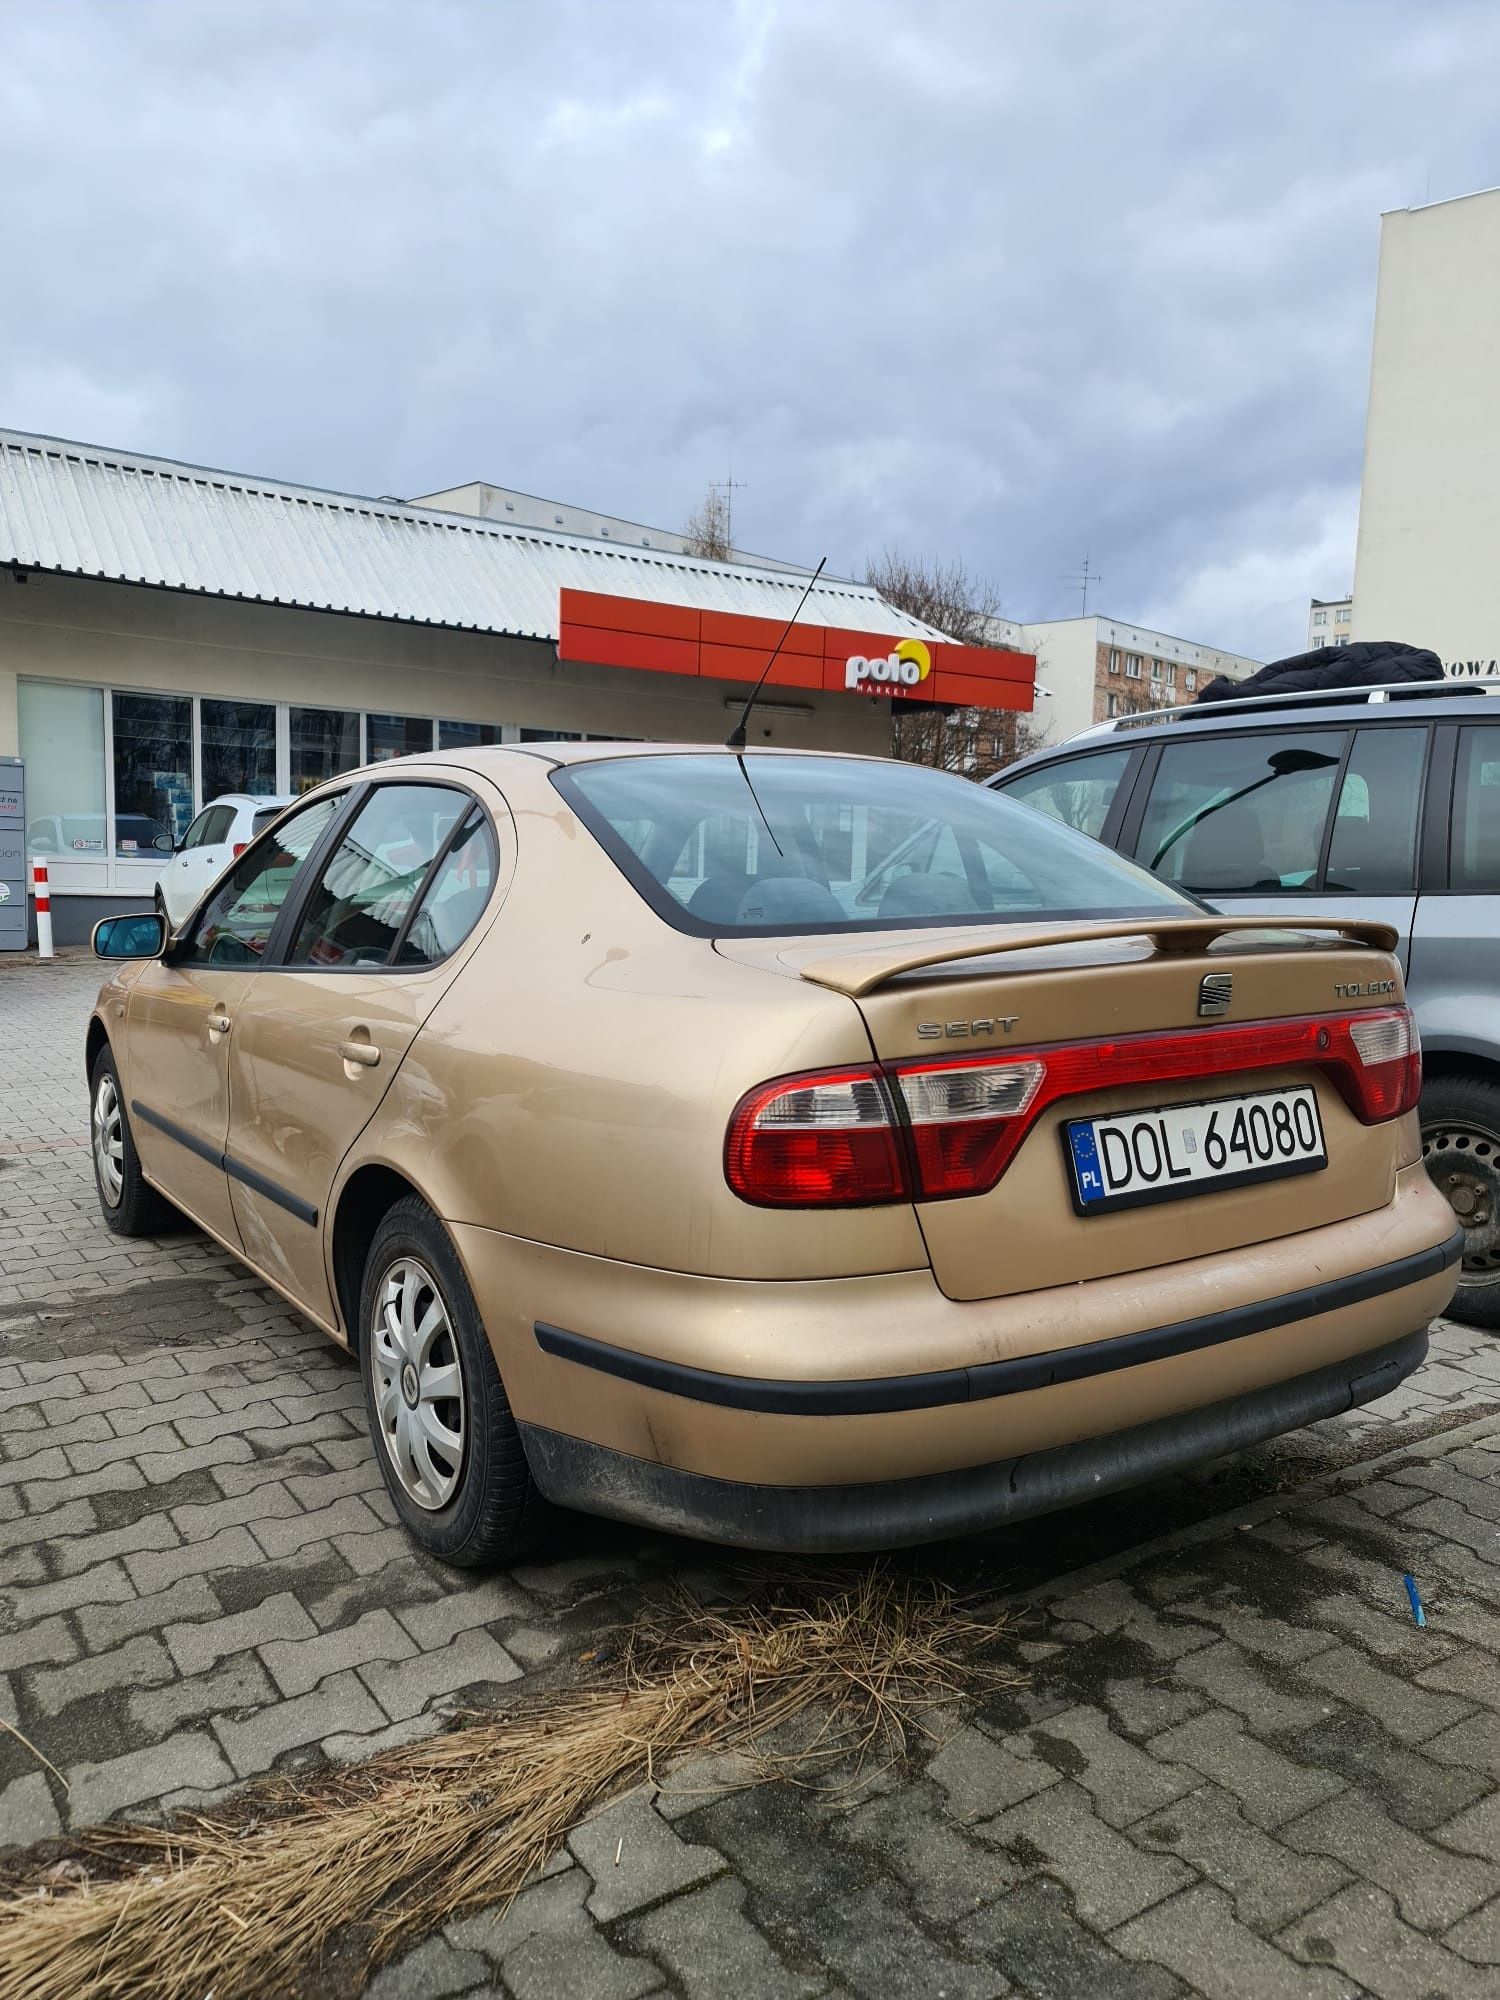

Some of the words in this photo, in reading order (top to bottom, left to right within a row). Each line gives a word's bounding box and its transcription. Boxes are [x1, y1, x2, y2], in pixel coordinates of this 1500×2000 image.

[845, 653, 920, 689] polo
[1444, 660, 1500, 677] OWA
[857, 684, 908, 697] MARKET
[1335, 980, 1395, 998] TOLEDO
[917, 1016, 1019, 1039] SEAT
[1099, 1120, 1192, 1190] DOL
[1204, 1097, 1317, 1170] 64080
[1082, 1170, 1101, 1189] PL
